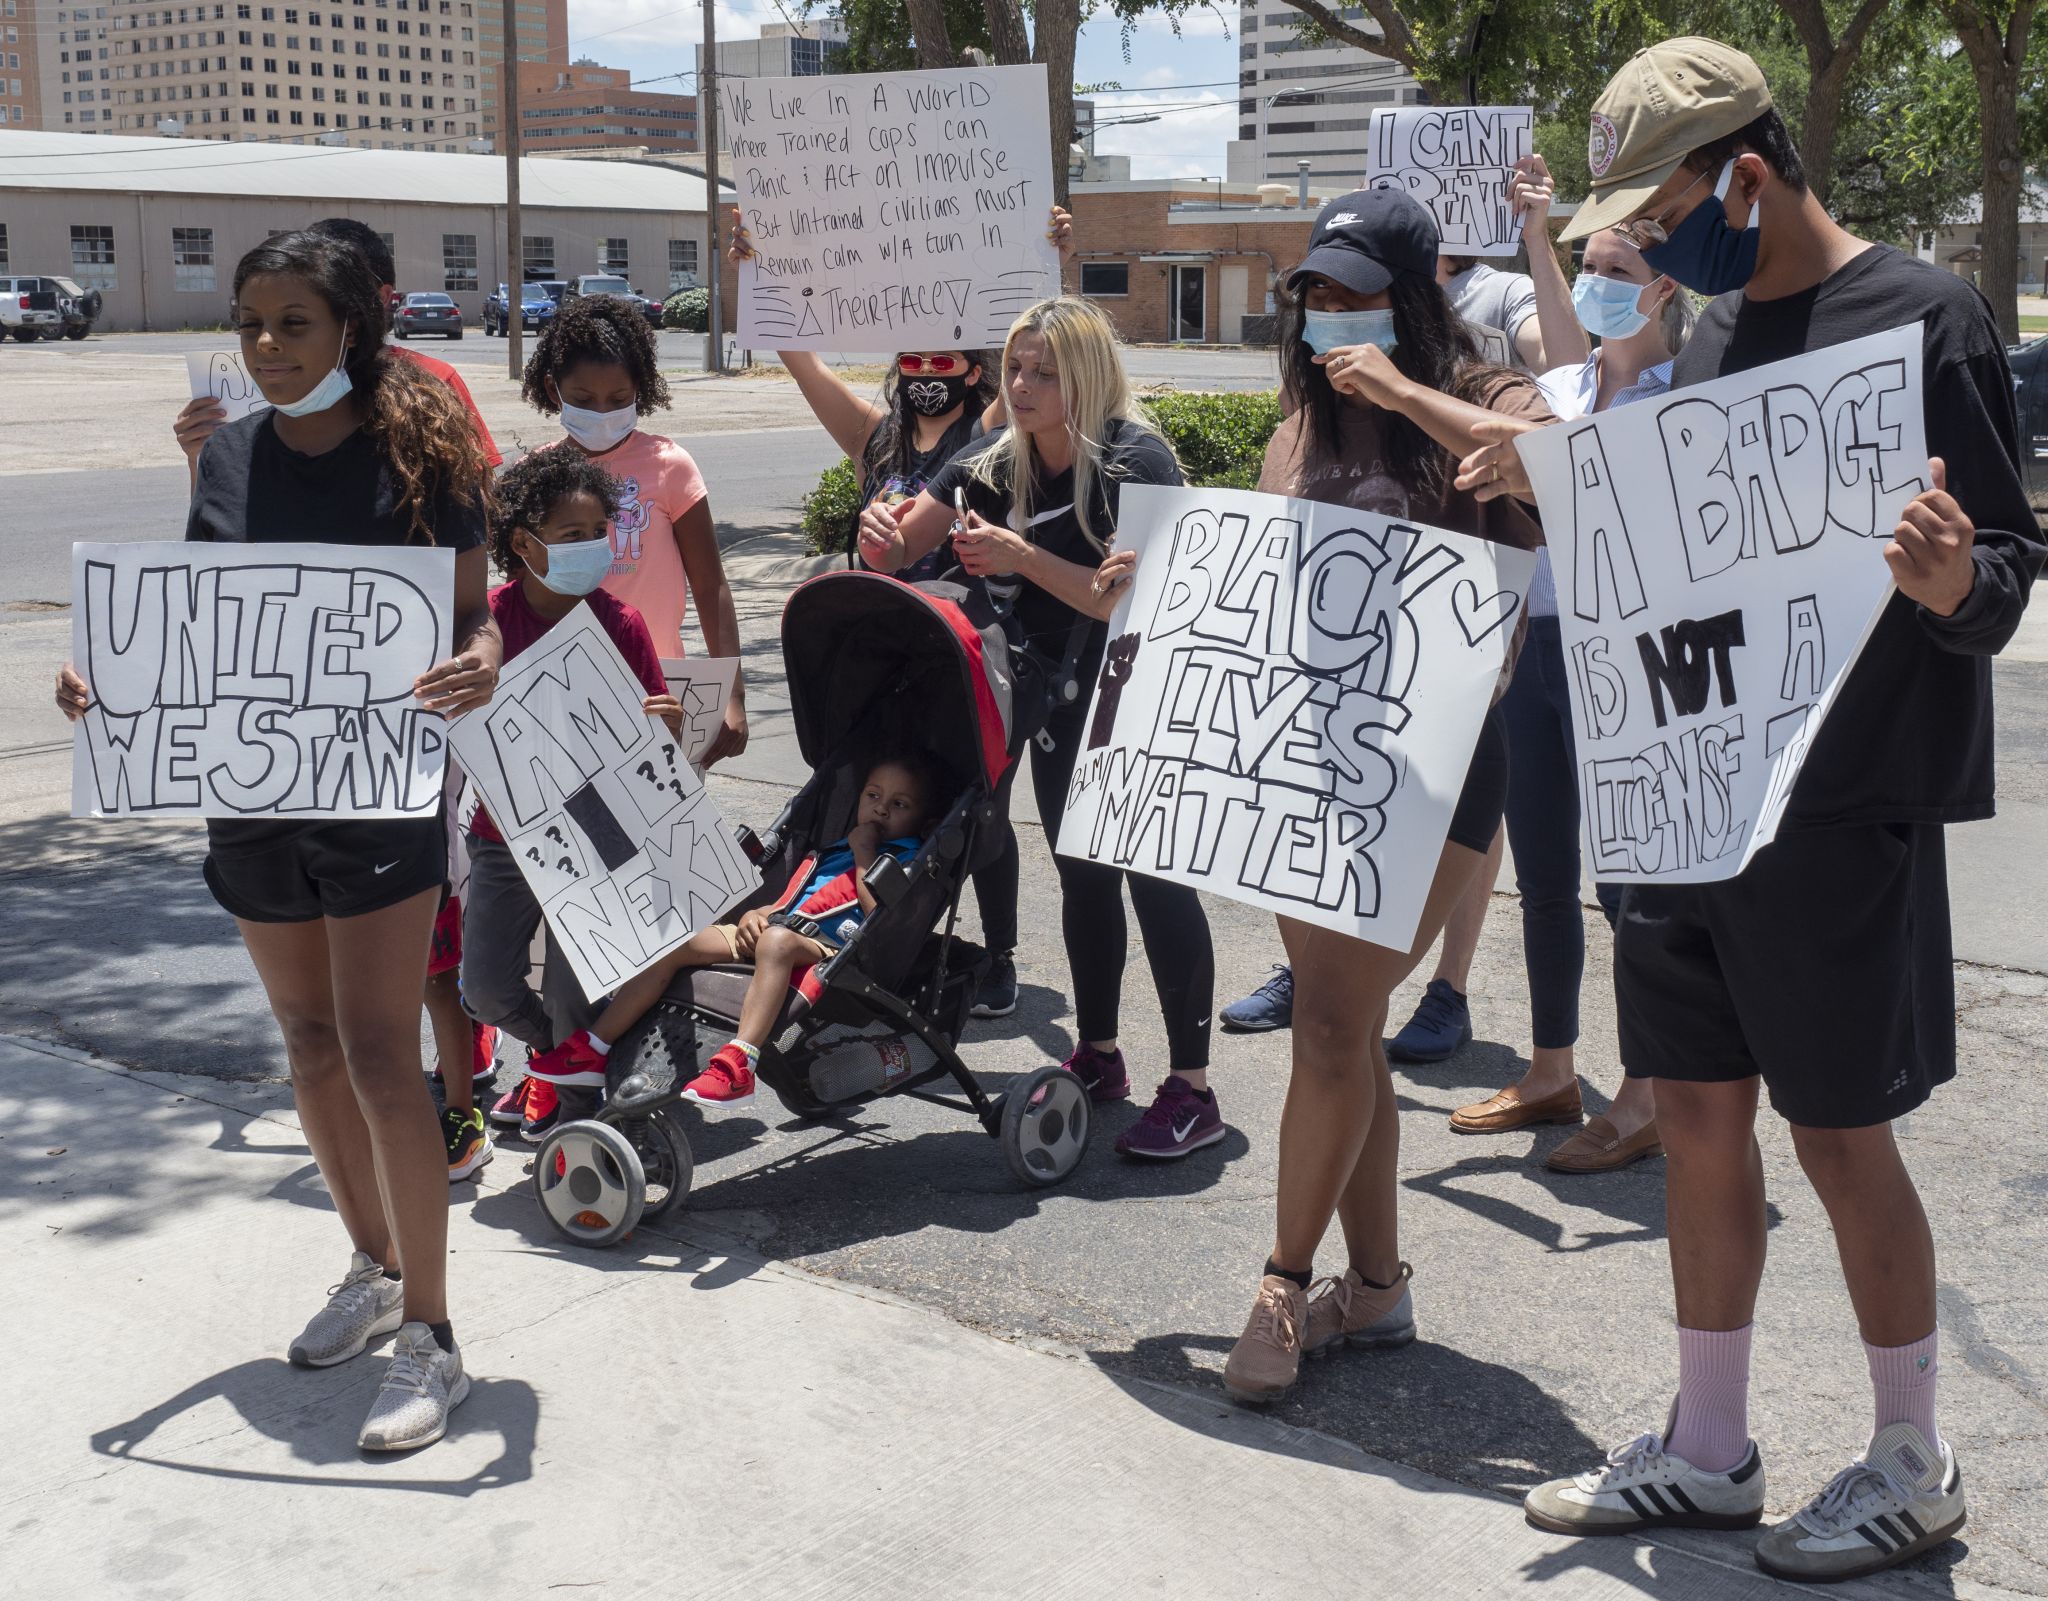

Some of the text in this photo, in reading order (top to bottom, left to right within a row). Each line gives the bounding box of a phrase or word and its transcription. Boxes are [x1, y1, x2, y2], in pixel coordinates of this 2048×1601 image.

[726, 81, 755, 127] We
[769, 88, 806, 120] Live
[873, 82, 888, 112] A
[777, 126, 849, 155] Trained
[1379, 109, 1531, 169] I CANT
[746, 167, 791, 199] Panic
[753, 245, 813, 282] Remain
[1568, 357, 1924, 623] A BADGE
[85, 559, 440, 717] UNITED
[1147, 508, 1466, 702] BLACK
[1571, 593, 1826, 741] IS NOT A
[82, 700, 447, 814] WE STAND
[485, 642, 642, 828] AM
[1147, 645, 1413, 810] LIVES
[1583, 713, 1747, 875] LICENSE
[1088, 746, 1387, 918] MATTER
